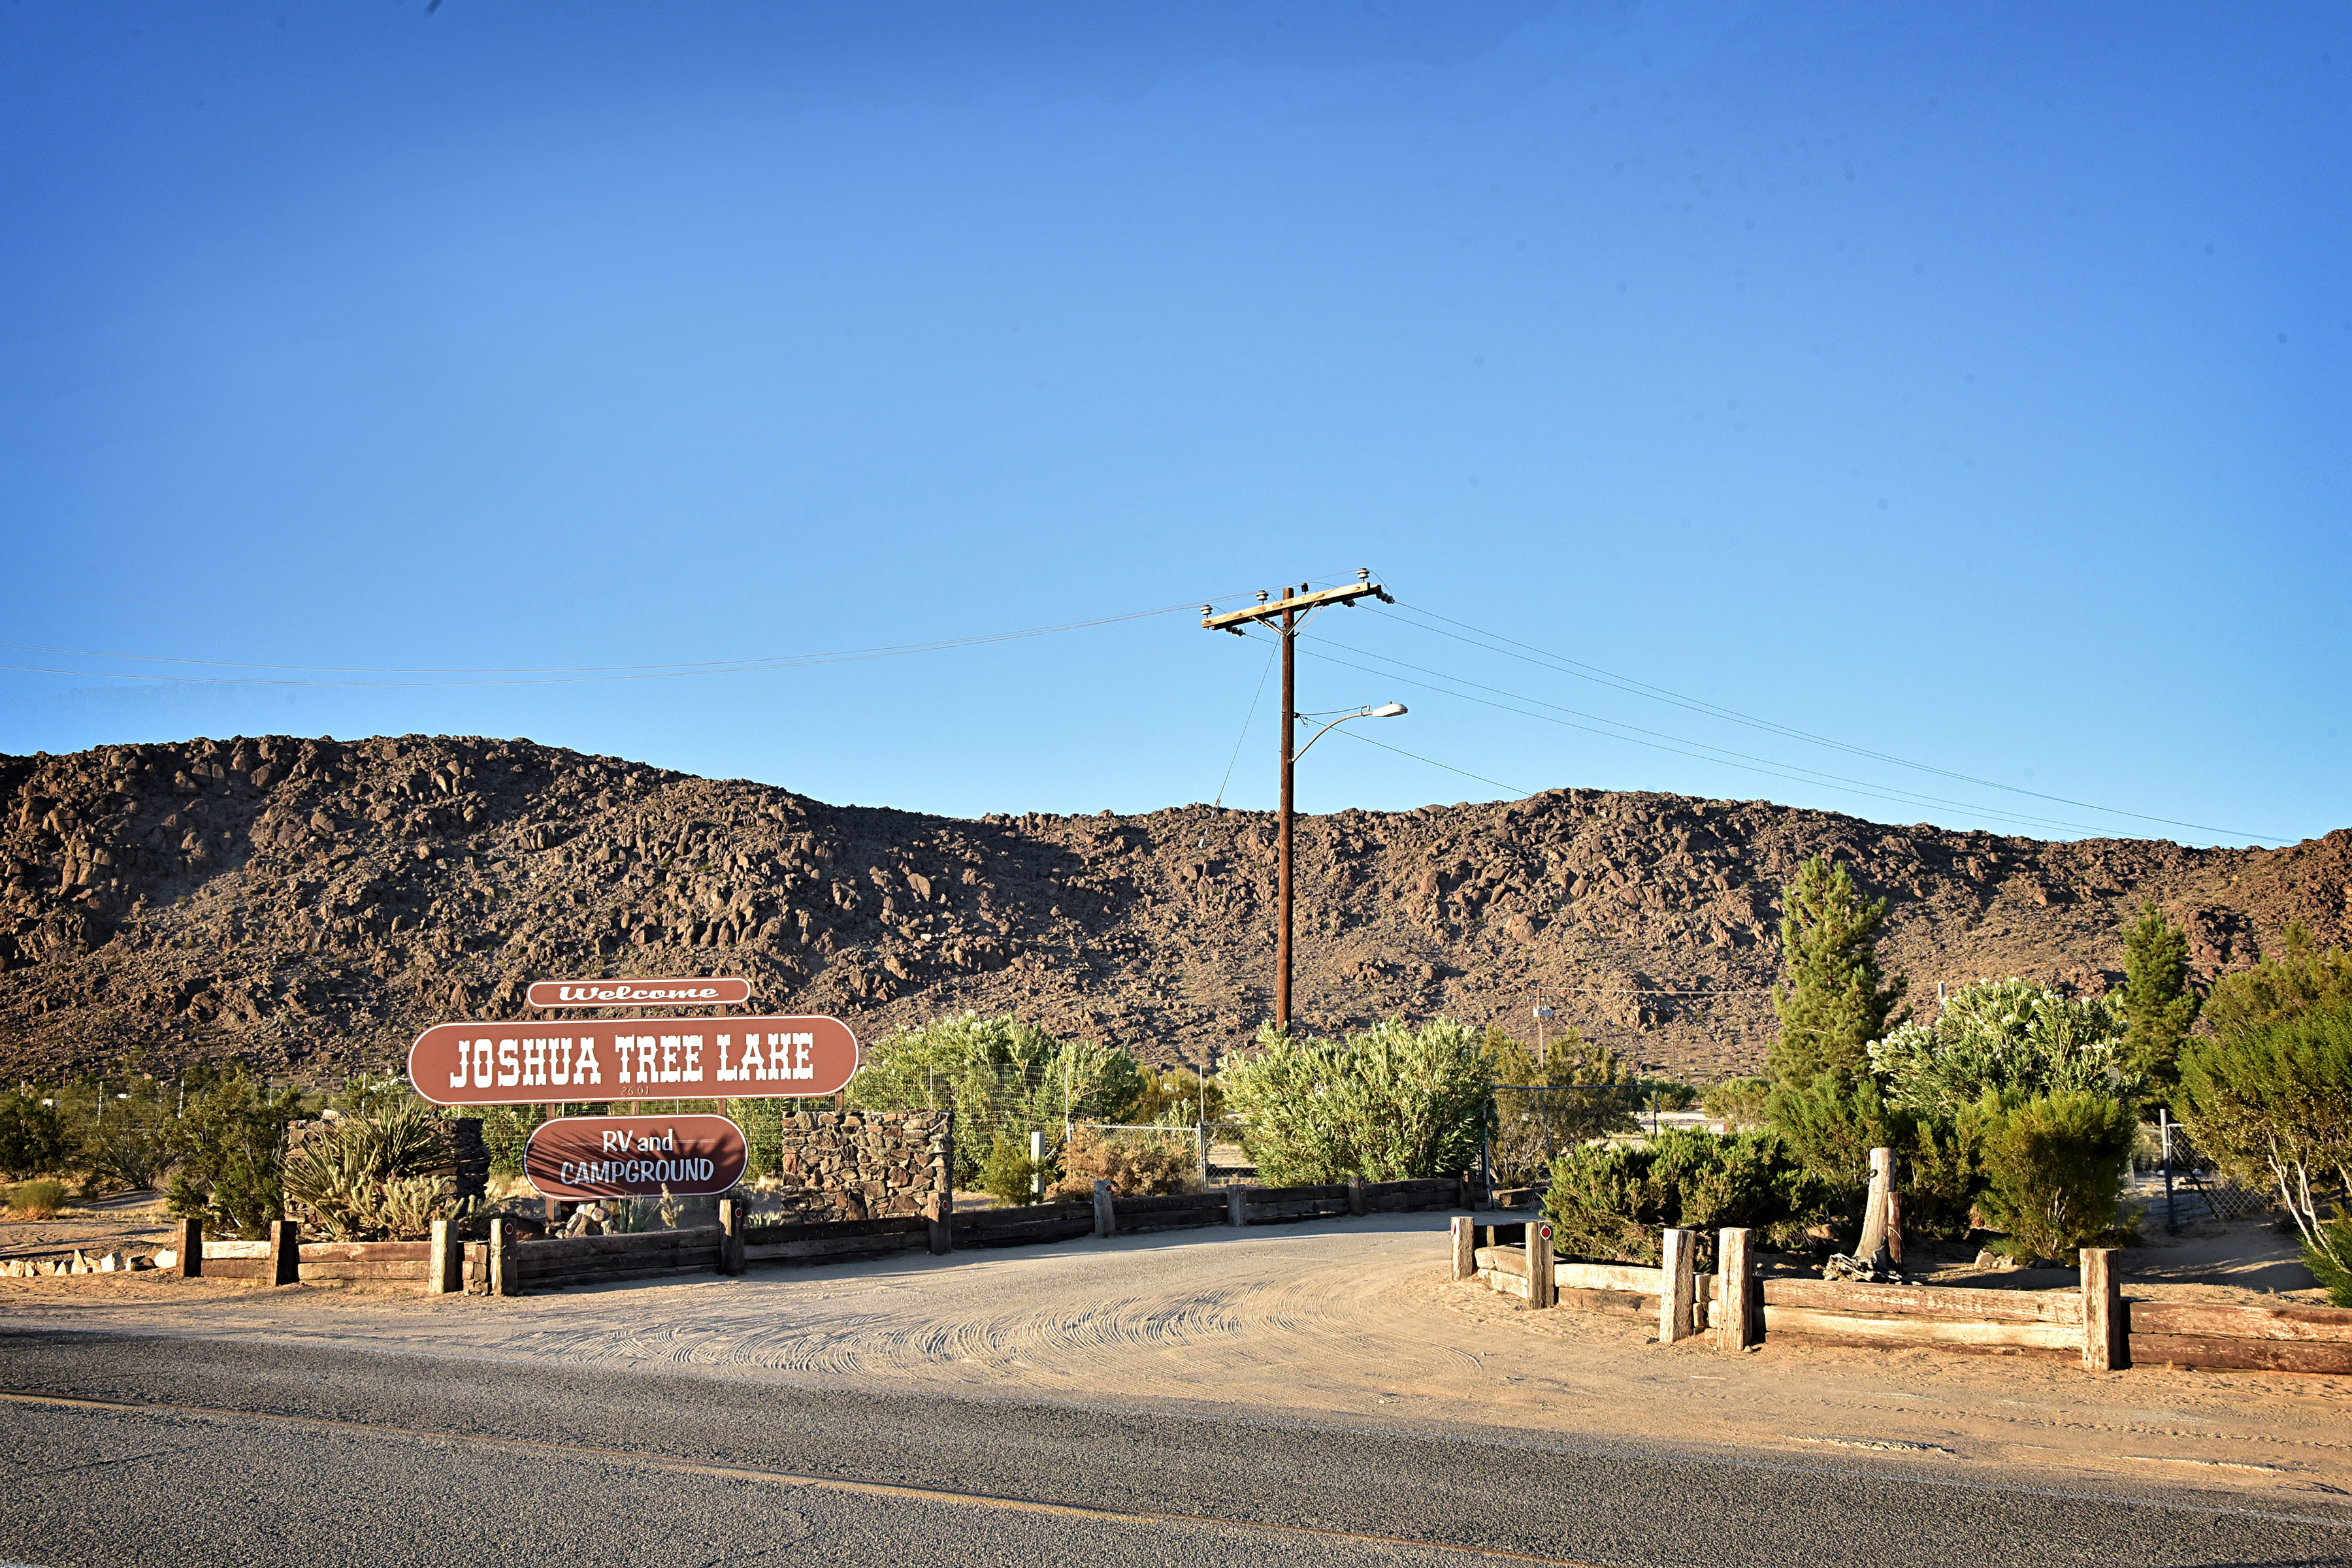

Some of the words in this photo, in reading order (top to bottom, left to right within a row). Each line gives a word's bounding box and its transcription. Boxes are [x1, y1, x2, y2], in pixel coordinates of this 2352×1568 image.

[559, 985, 719, 1001] Welcome
[449, 1037, 601, 1088] JOSHUA
[615, 1034, 703, 1084] TREE
[717, 1032, 813, 1081] LAKE
[620, 1085, 650, 1096] 2601
[602, 1130, 634, 1152] RV
[637, 1128, 674, 1152] and
[561, 1157, 714, 1184] CAMPGROUND
